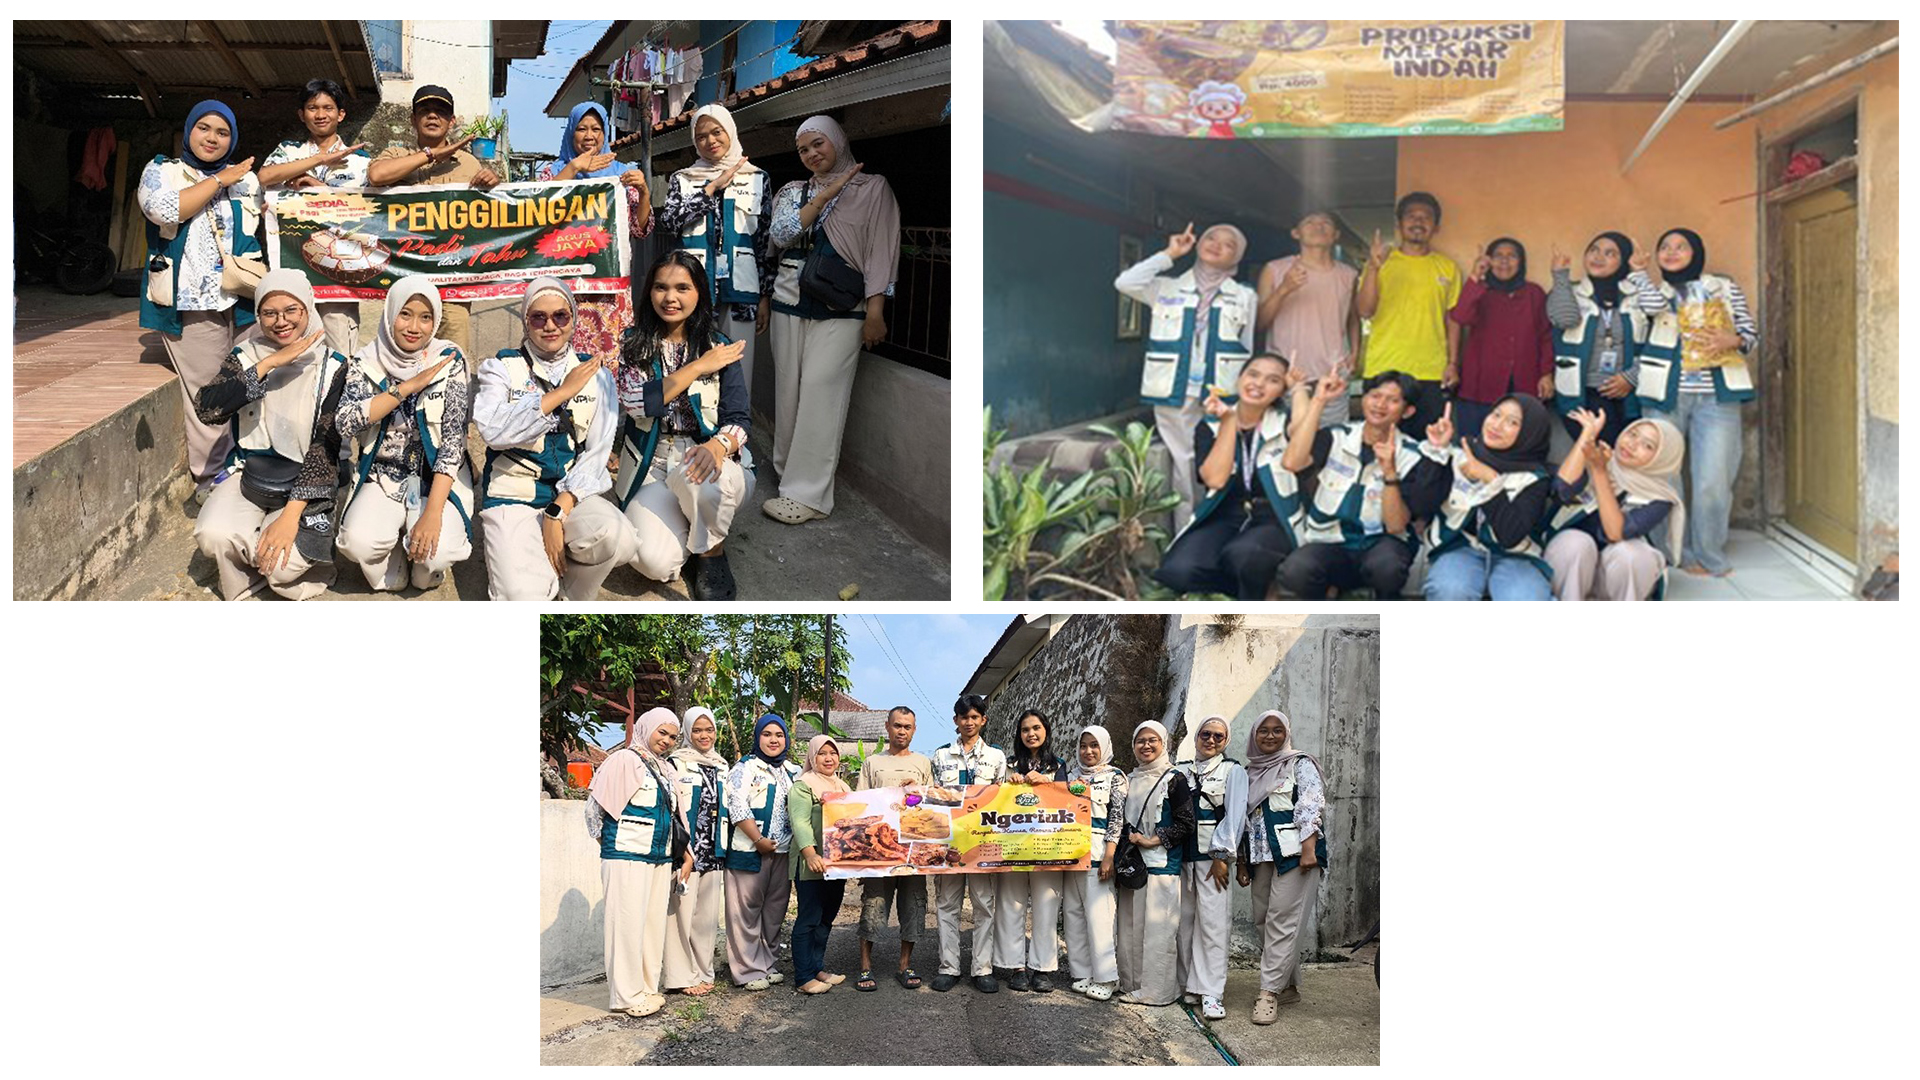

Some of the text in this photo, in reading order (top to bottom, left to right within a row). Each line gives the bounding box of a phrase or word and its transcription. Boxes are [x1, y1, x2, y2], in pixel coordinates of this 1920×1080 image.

[1361, 23, 1532, 46] PRODUKSI
[1383, 40, 1508, 60] MEKAR
[1393, 59, 1498, 79] INDAH
[387, 192, 609, 232] PENGGILINGAN
[396, 233, 465, 258] Padi
[552, 239, 597, 254] JAYA
[555, 231, 592, 244] AGUS
[437, 256, 464, 268] dan
[467, 241, 529, 268] Tahu
